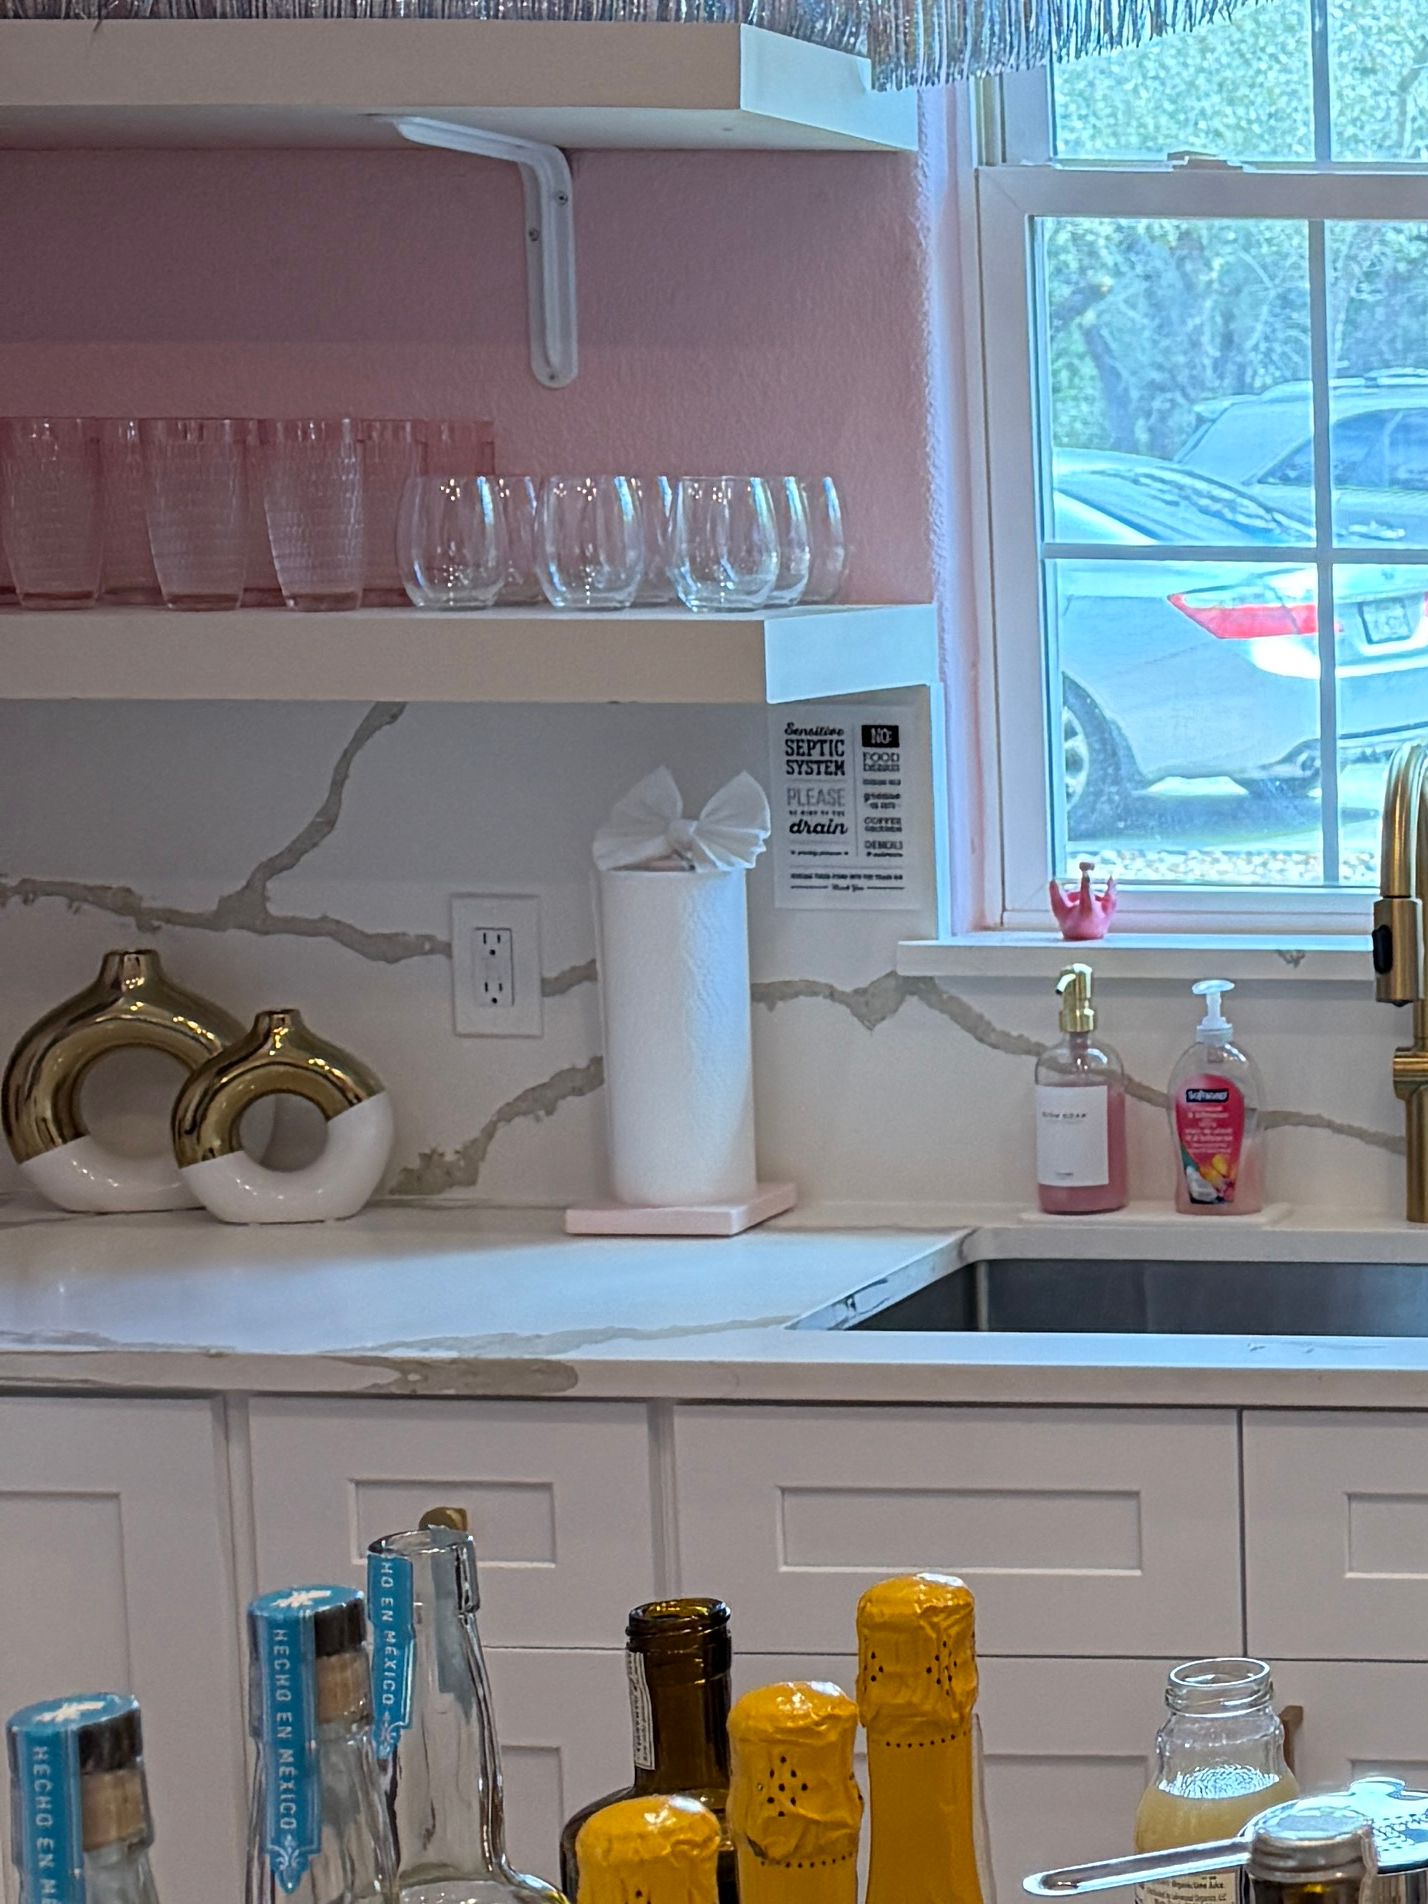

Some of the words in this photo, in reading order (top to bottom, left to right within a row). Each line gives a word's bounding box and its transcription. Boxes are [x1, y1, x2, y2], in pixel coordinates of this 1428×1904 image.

[785, 739, 844, 757] SEPTIC
[786, 760, 845, 775] SYSTEM
[787, 788, 845, 807] PLEASE
[789, 818, 848, 834] drain
[381, 1598, 394, 1622] EN
[273, 1629, 292, 1701] HECHO
[277, 1712, 293, 1738] EN
[33, 1746, 54, 1826] HECHO
[277, 1748, 298, 1830] MÉXICO
[36, 1837, 55, 1868] EN
